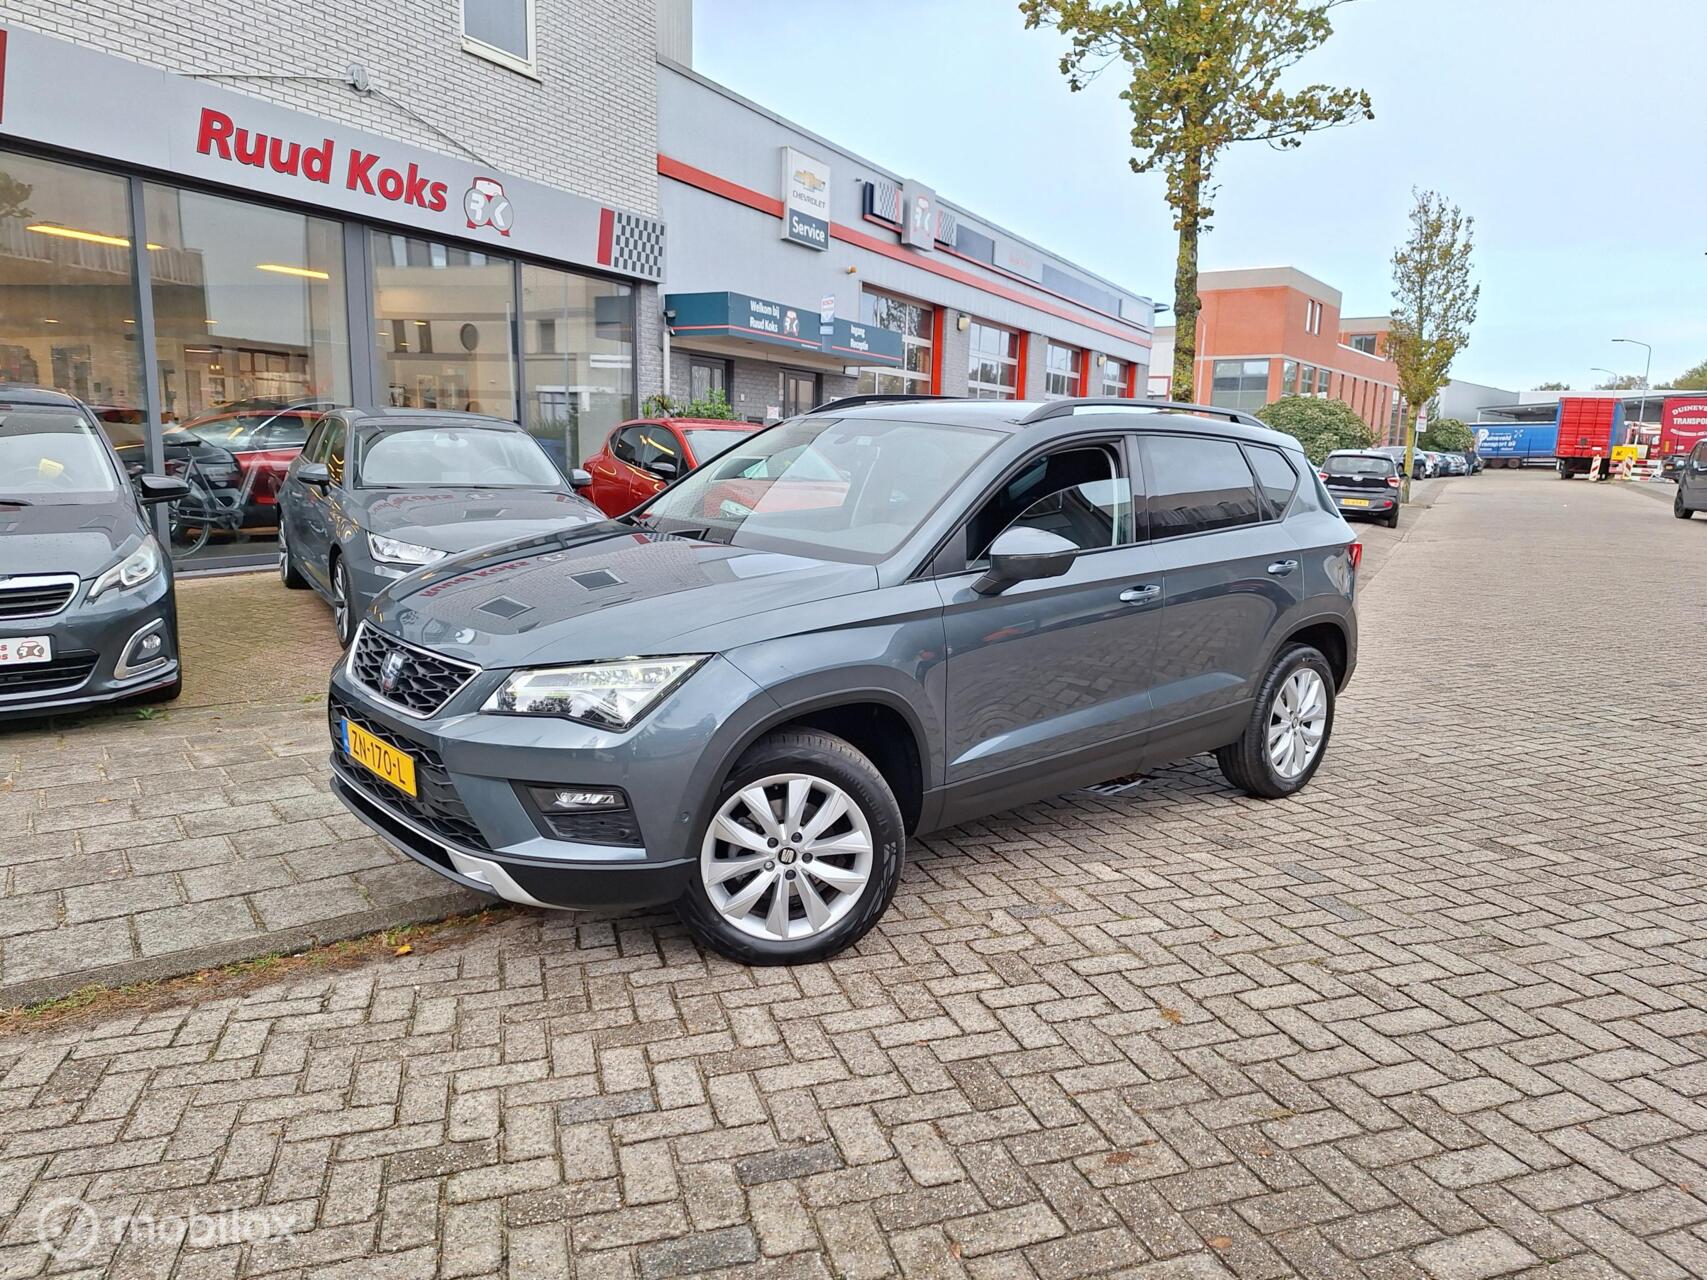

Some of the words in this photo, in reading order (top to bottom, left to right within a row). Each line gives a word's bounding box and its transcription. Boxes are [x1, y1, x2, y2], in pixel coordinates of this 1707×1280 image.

[196, 107, 334, 184] Ruud
[346, 149, 448, 212] Koks
[792, 190, 826, 209] CHEVROLET
[792, 215, 825, 242] Service
[750, 300, 772, 316] Welkom
[772, 304, 780, 319] bij
[750, 316, 764, 330] Ruud
[764, 319, 778, 332] Koks
[351, 729, 406, 785] ZN-170-L
